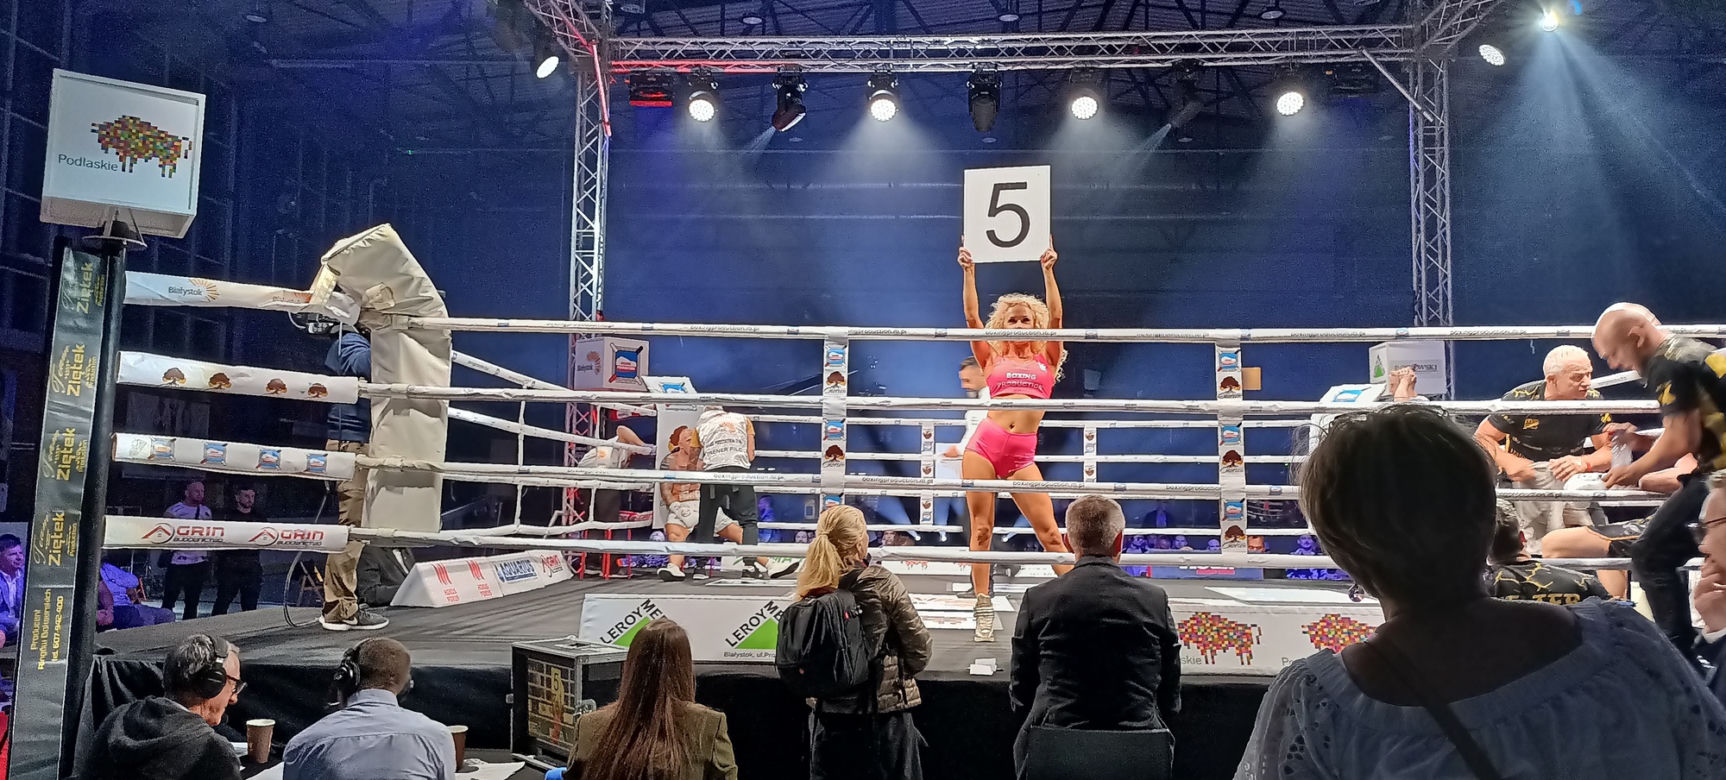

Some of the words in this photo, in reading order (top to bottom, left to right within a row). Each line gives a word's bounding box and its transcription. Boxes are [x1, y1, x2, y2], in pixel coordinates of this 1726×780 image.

[58, 153, 119, 172] Podlaskie
[986, 181, 1030, 248] 5
[168, 286, 203, 297] Białystok
[48, 511, 65, 566] Ziętek
[177, 525, 224, 537] GRIN
[280, 530, 324, 540] GRIN
[30, 609, 41, 650] Producent
[600, 606, 643, 644] LEROY
[725, 608, 767, 647] LEROY
